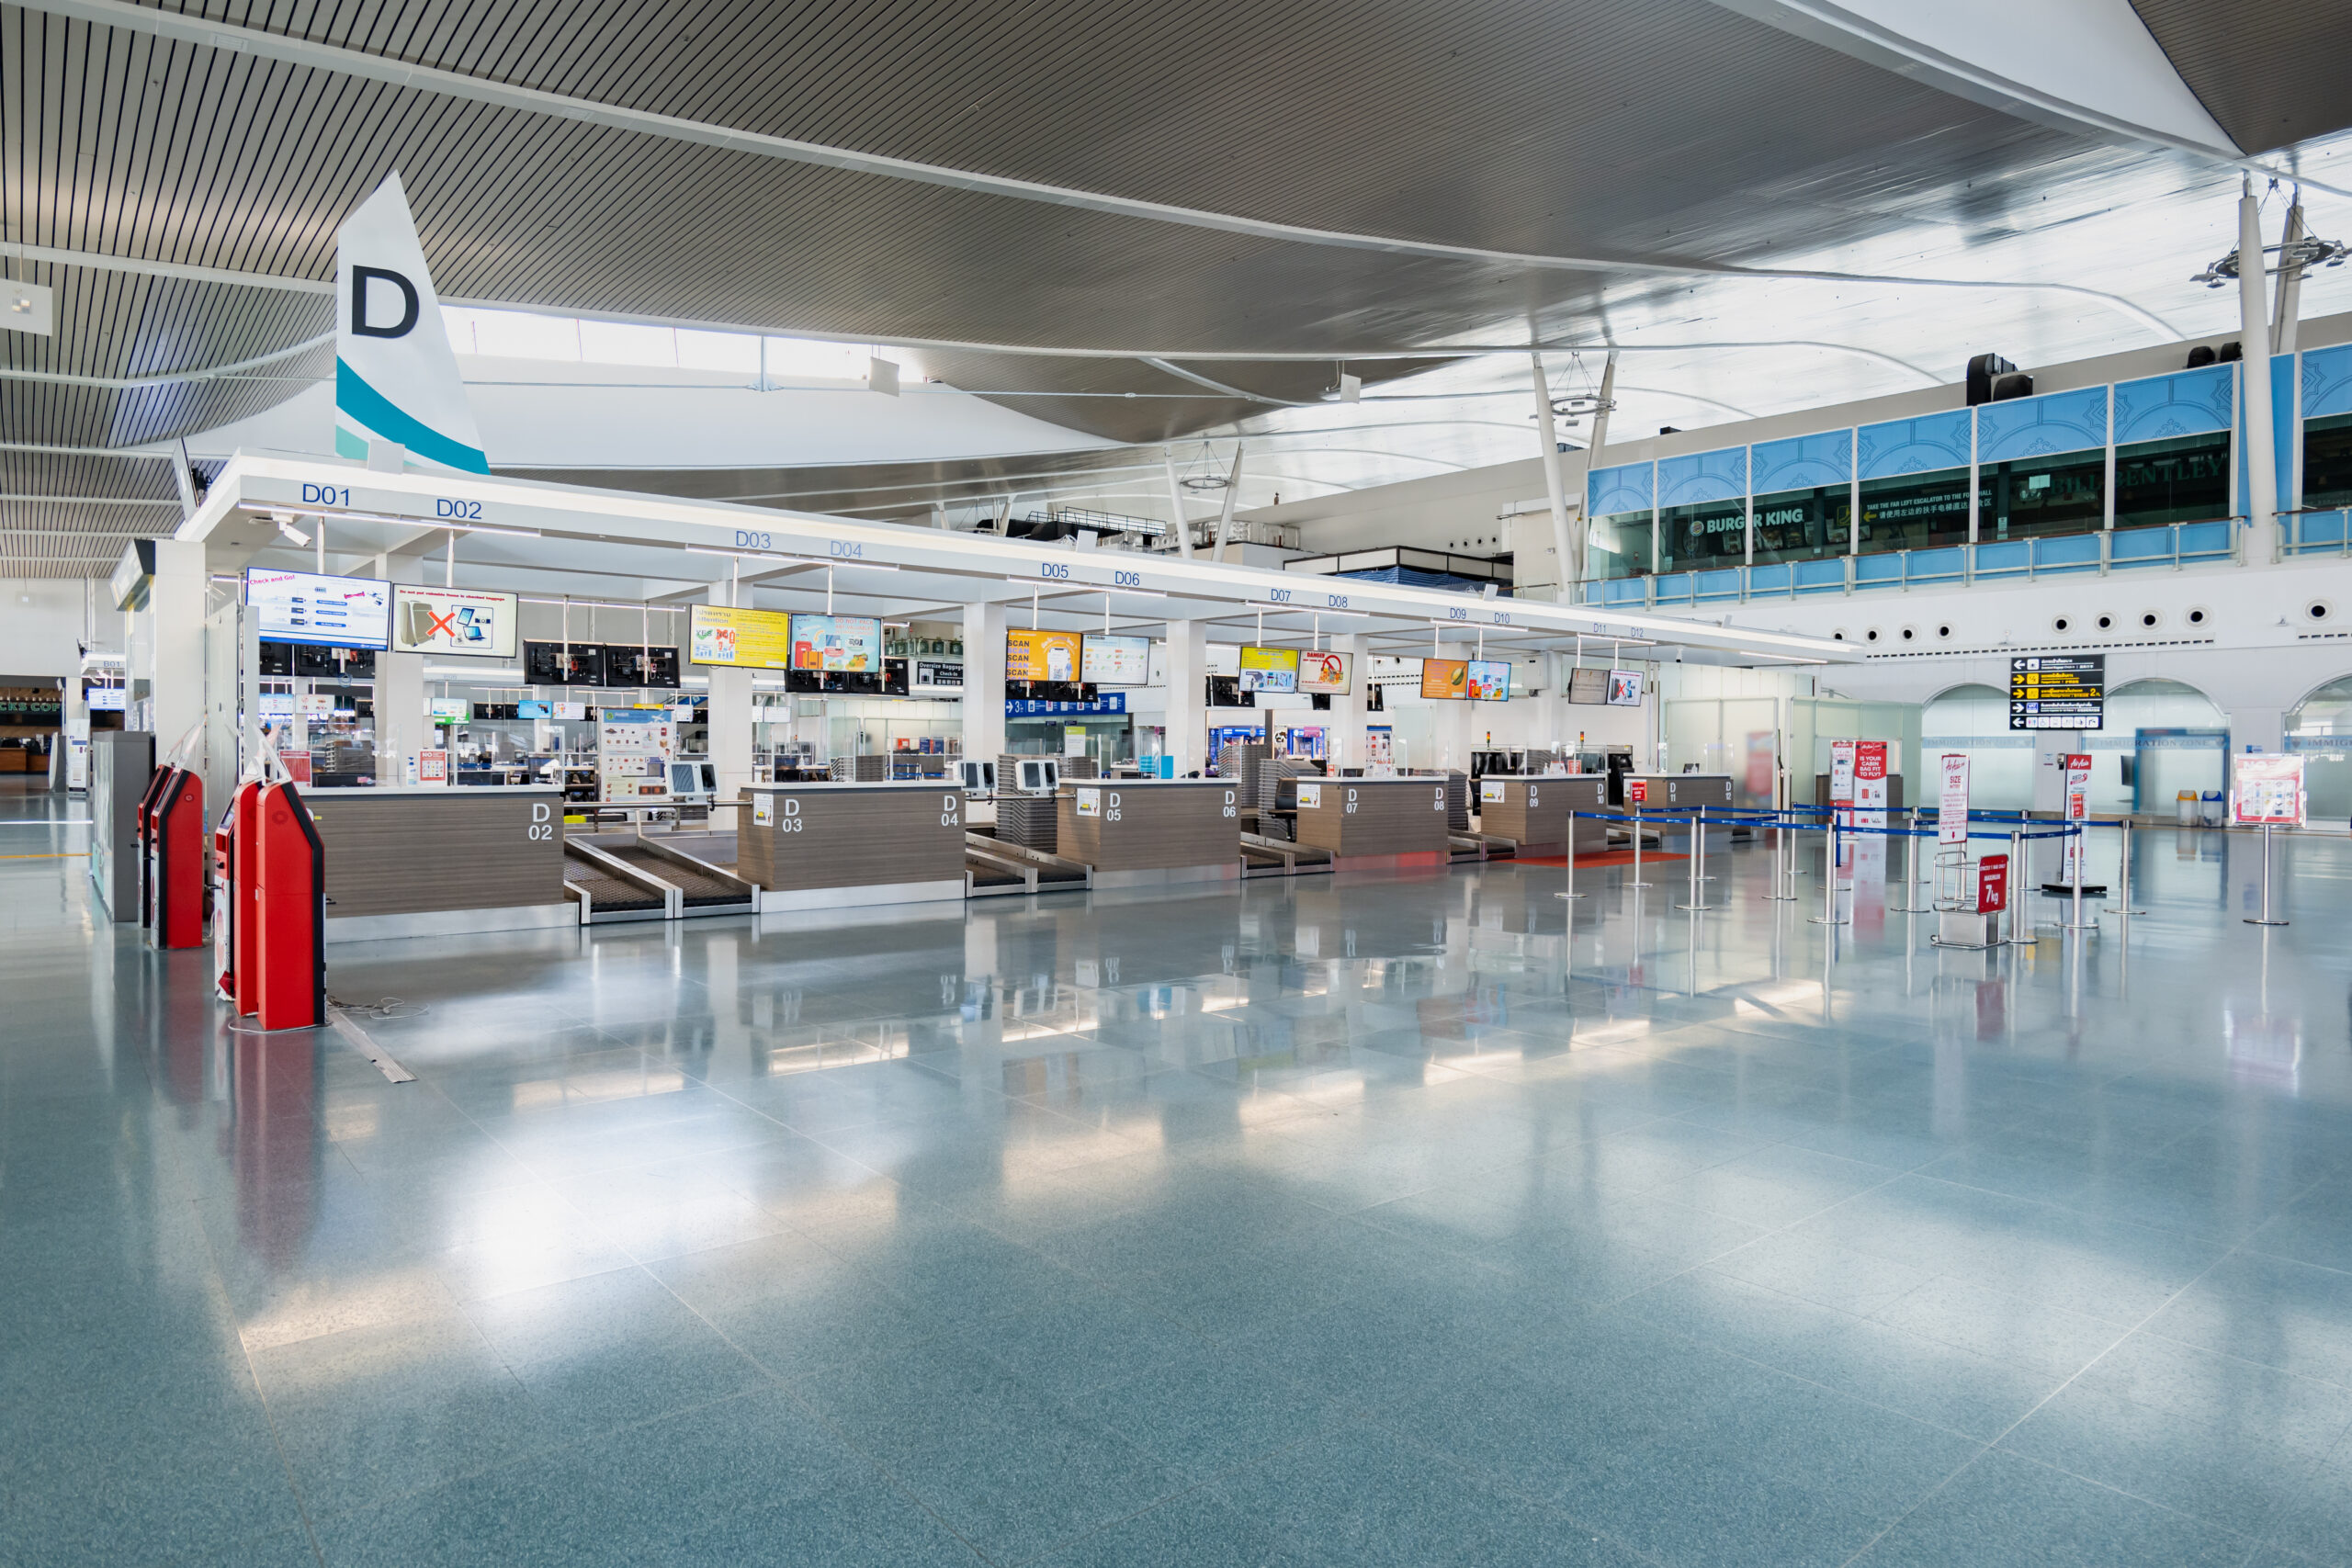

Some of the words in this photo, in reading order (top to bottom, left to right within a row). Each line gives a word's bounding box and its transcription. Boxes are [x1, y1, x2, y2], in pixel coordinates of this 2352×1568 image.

[352, 265, 419, 339] D
[302, 483, 349, 506] D01
[1914, 495, 1942, 504] ESCALATOR
[436, 499, 481, 520] D02
[1707, 513, 1762, 533] BURGR
[1766, 508, 1804, 526] KING
[736, 530, 771, 548] D03
[831, 540, 862, 558] D04
[1042, 563, 1069, 578] D05
[249, 577, 269, 585] Check
[1114, 571, 1139, 586] D06
[1271, 588, 1291, 602] D07
[1329, 594, 1348, 608] D08
[1450, 607, 1466, 619] D09
[1494, 613, 1510, 624] D10
[1594, 623, 1606, 633] D11
[1631, 627, 1644, 637] D12
[2090, 687, 2096, 696] 2
[2070, 758, 2089, 769] AirAsia
[1950, 775, 1962, 784] SIZE
[1435, 787, 1443, 799] D
[1530, 785, 1537, 796] D
[1597, 784, 1603, 795] D
[1669, 782, 1676, 793] D
[1110, 793, 1121, 807] D
[1225, 791, 1235, 805] D
[1348, 788, 1357, 802] D
[1597, 795, 1604, 804] 10
[1669, 794, 1676, 802] 11
[785, 798, 799, 816] D
[944, 795, 956, 811] D
[1434, 801, 1444, 811] 08
[1529, 797, 1538, 807] 09
[533, 803, 550, 822] D
[1223, 806, 1236, 817] 06
[1346, 803, 1358, 814] 07
[941, 813, 958, 826] 04
[1106, 809, 1121, 821] 05
[783, 818, 803, 832] 03
[528, 825, 552, 840] 02
[1985, 884, 1998, 905] 7kg
